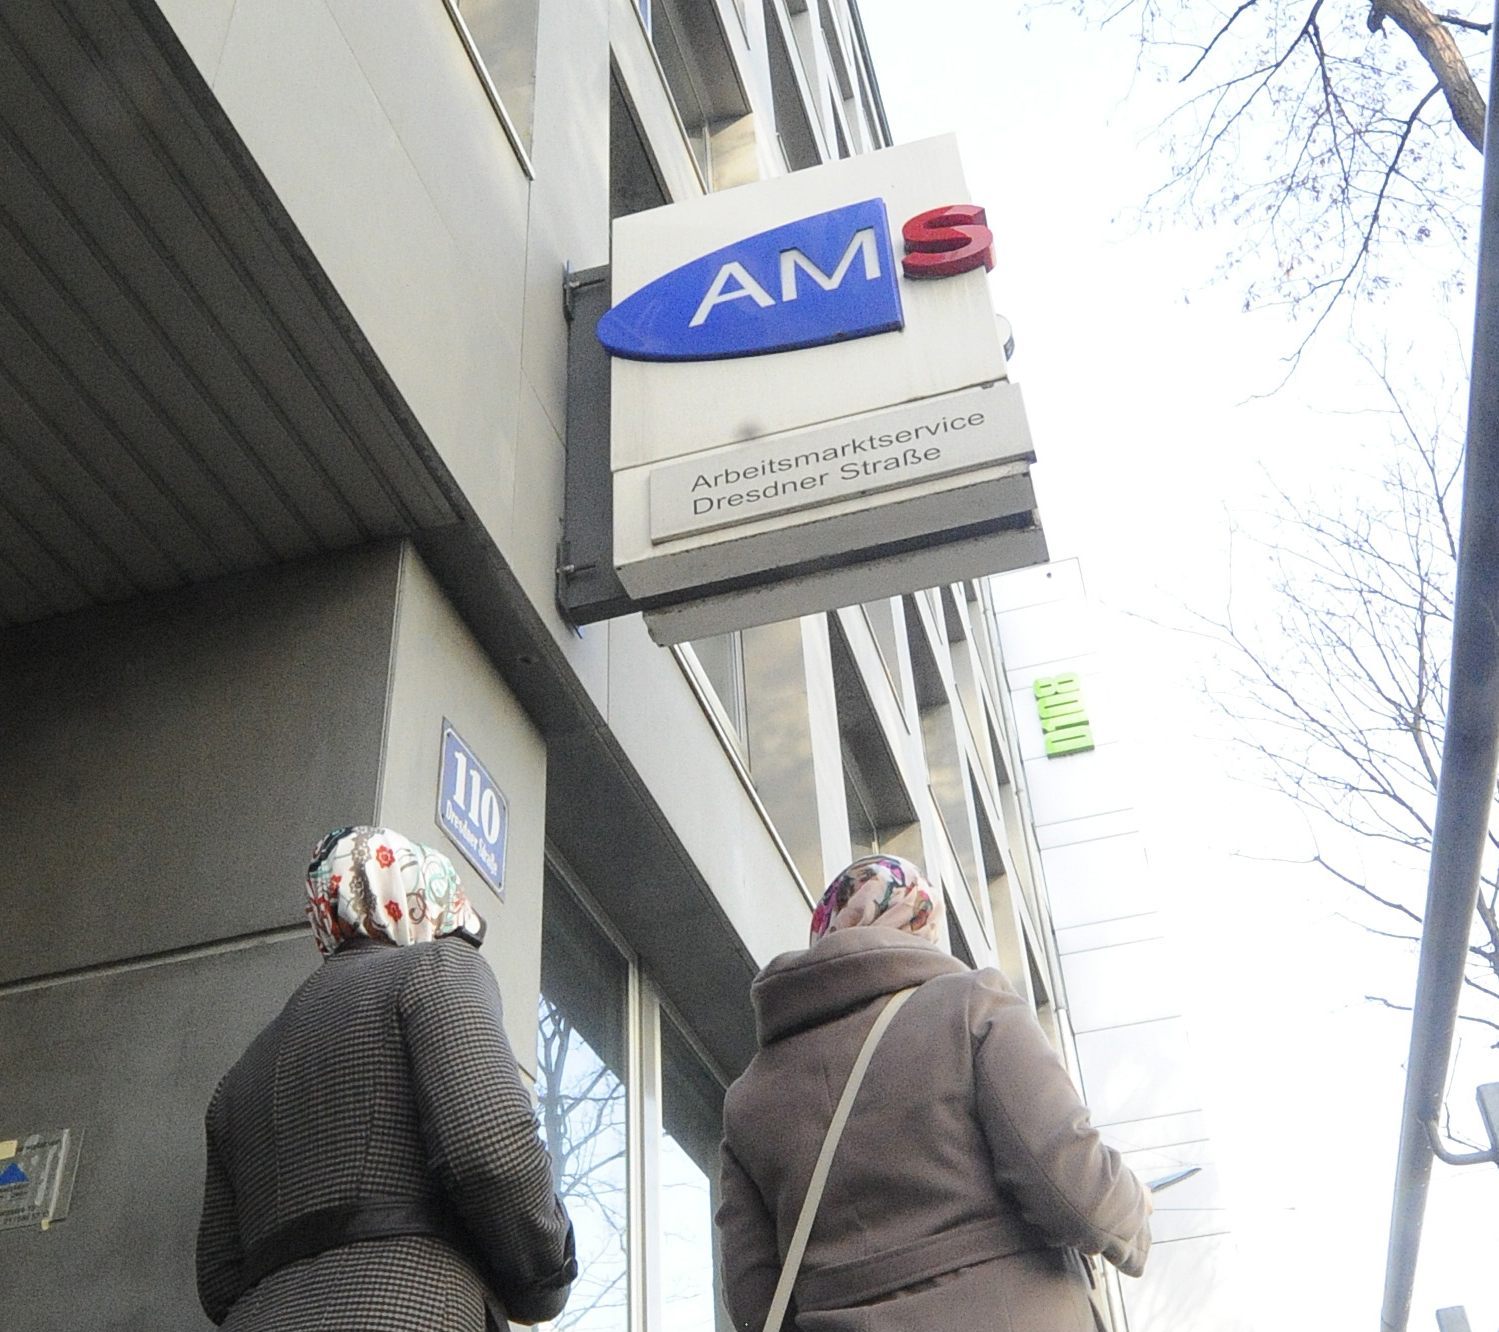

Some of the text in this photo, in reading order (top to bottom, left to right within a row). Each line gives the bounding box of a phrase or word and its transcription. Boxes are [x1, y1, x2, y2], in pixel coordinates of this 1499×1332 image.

[688, 204, 994, 328] AMS
[691, 409, 986, 492] Arbeitsmarktservice
[693, 445, 942, 515] Dresdner Straße
[453, 751, 501, 845] 110
